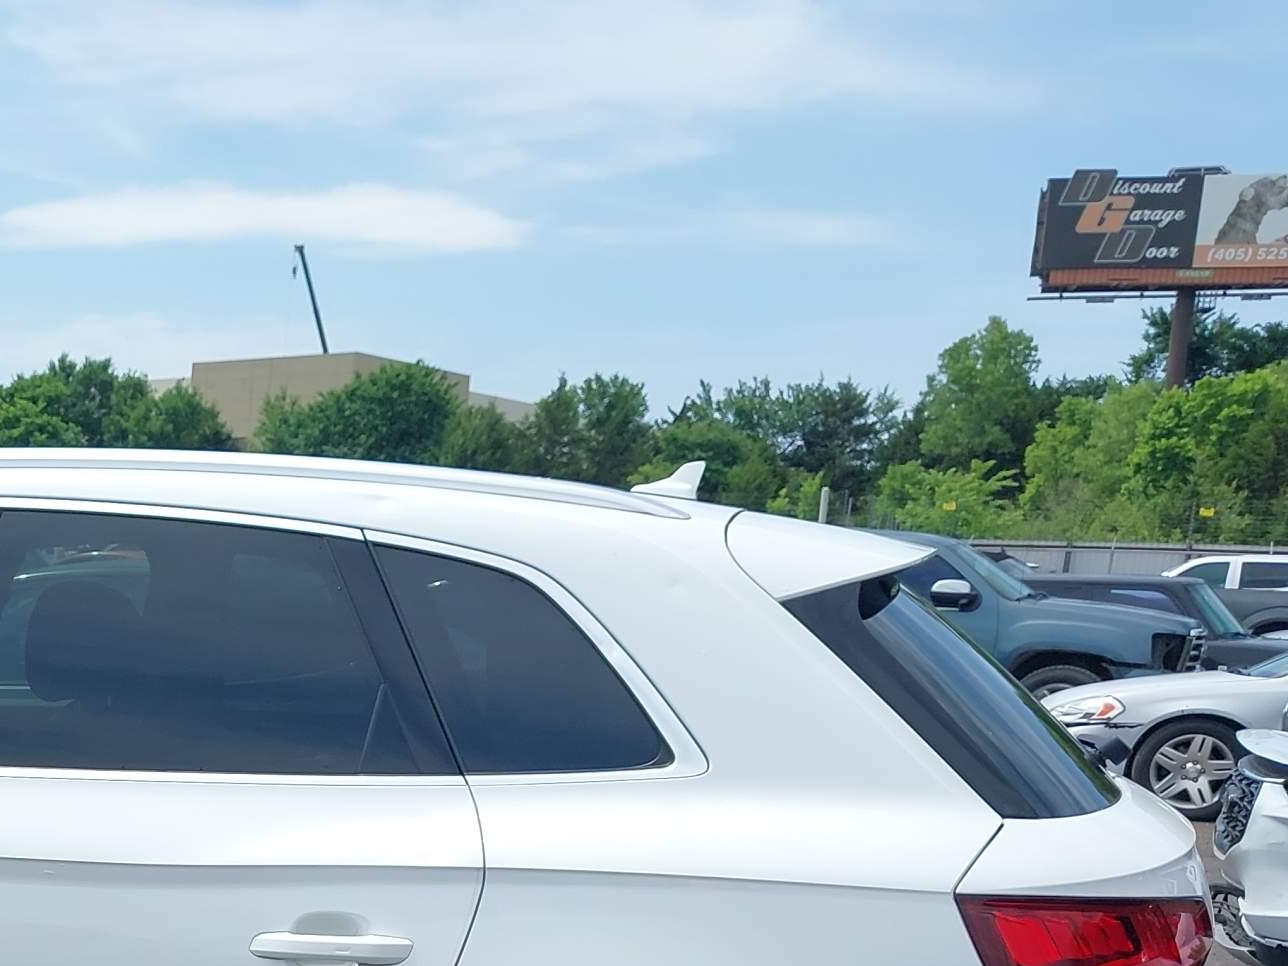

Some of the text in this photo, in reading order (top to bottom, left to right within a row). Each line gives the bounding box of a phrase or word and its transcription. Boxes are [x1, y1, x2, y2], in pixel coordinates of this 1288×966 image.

[1059, 169, 1185, 205] Discount
[1075, 195, 1186, 232] Garage
[1094, 225, 1179, 263] Door
[1207, 247, 1252, 262] (405)
